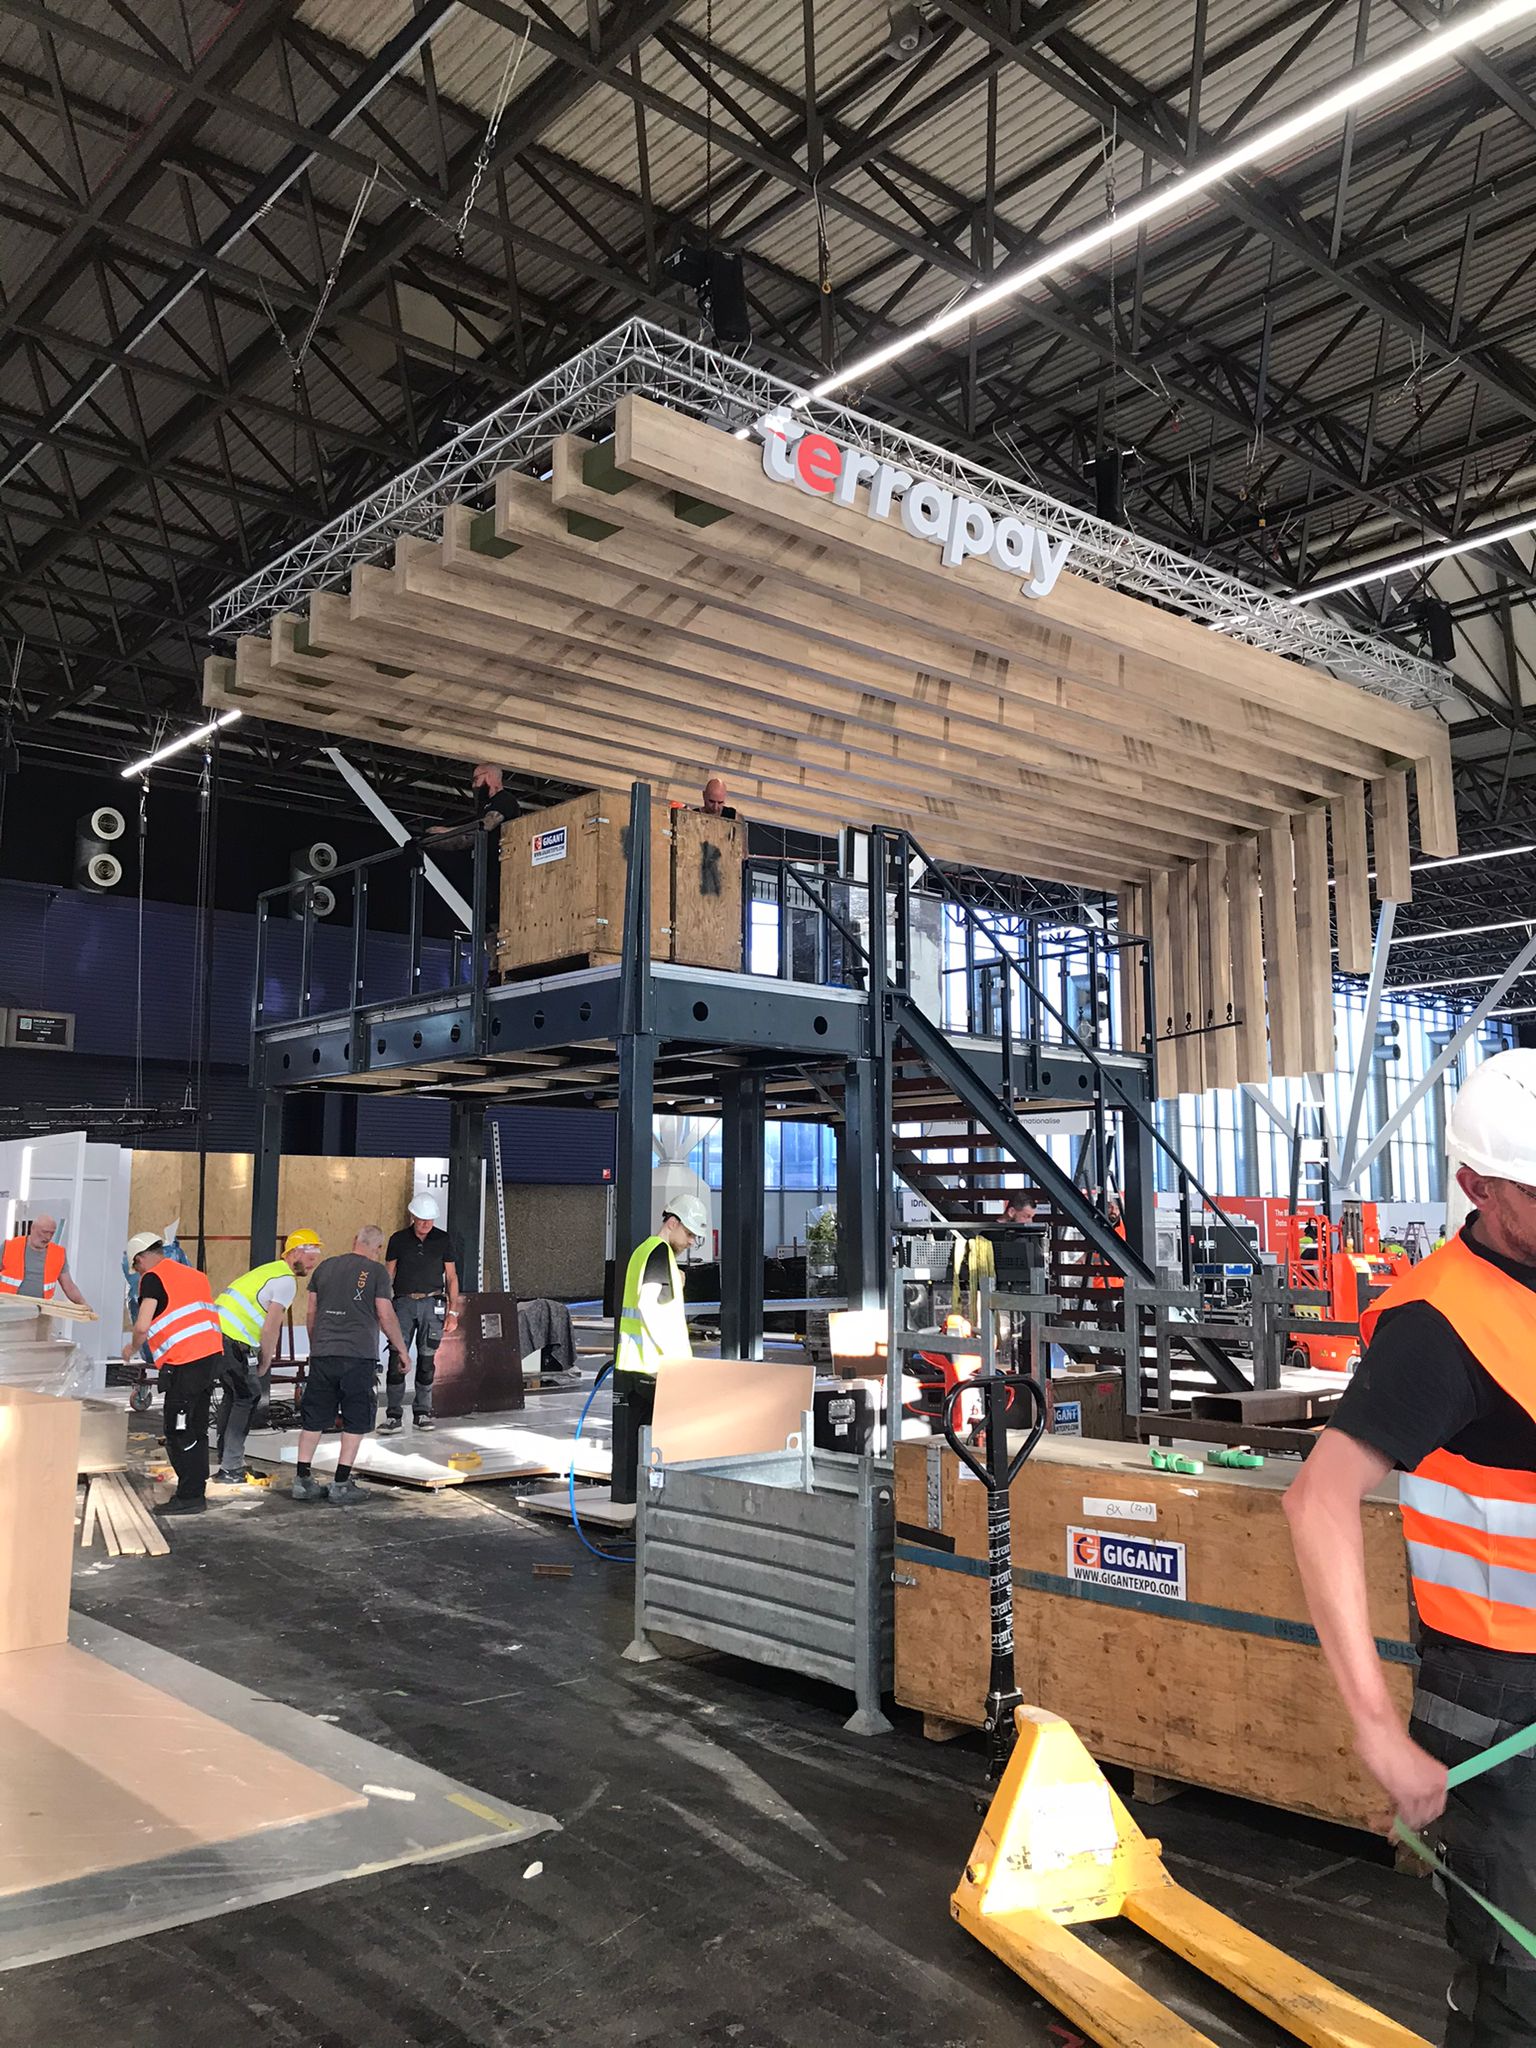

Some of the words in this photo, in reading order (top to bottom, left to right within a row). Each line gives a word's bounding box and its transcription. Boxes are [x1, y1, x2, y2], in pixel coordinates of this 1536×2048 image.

[756, 406, 1073, 599] terrapay
[542, 832, 564, 847] GIGANT
[357, 1270, 369, 1289] GIX
[1103, 1544, 1174, 1574] GIGANT
[1074, 1567, 1179, 1597] WWW.GIGANTEXPO.COM
